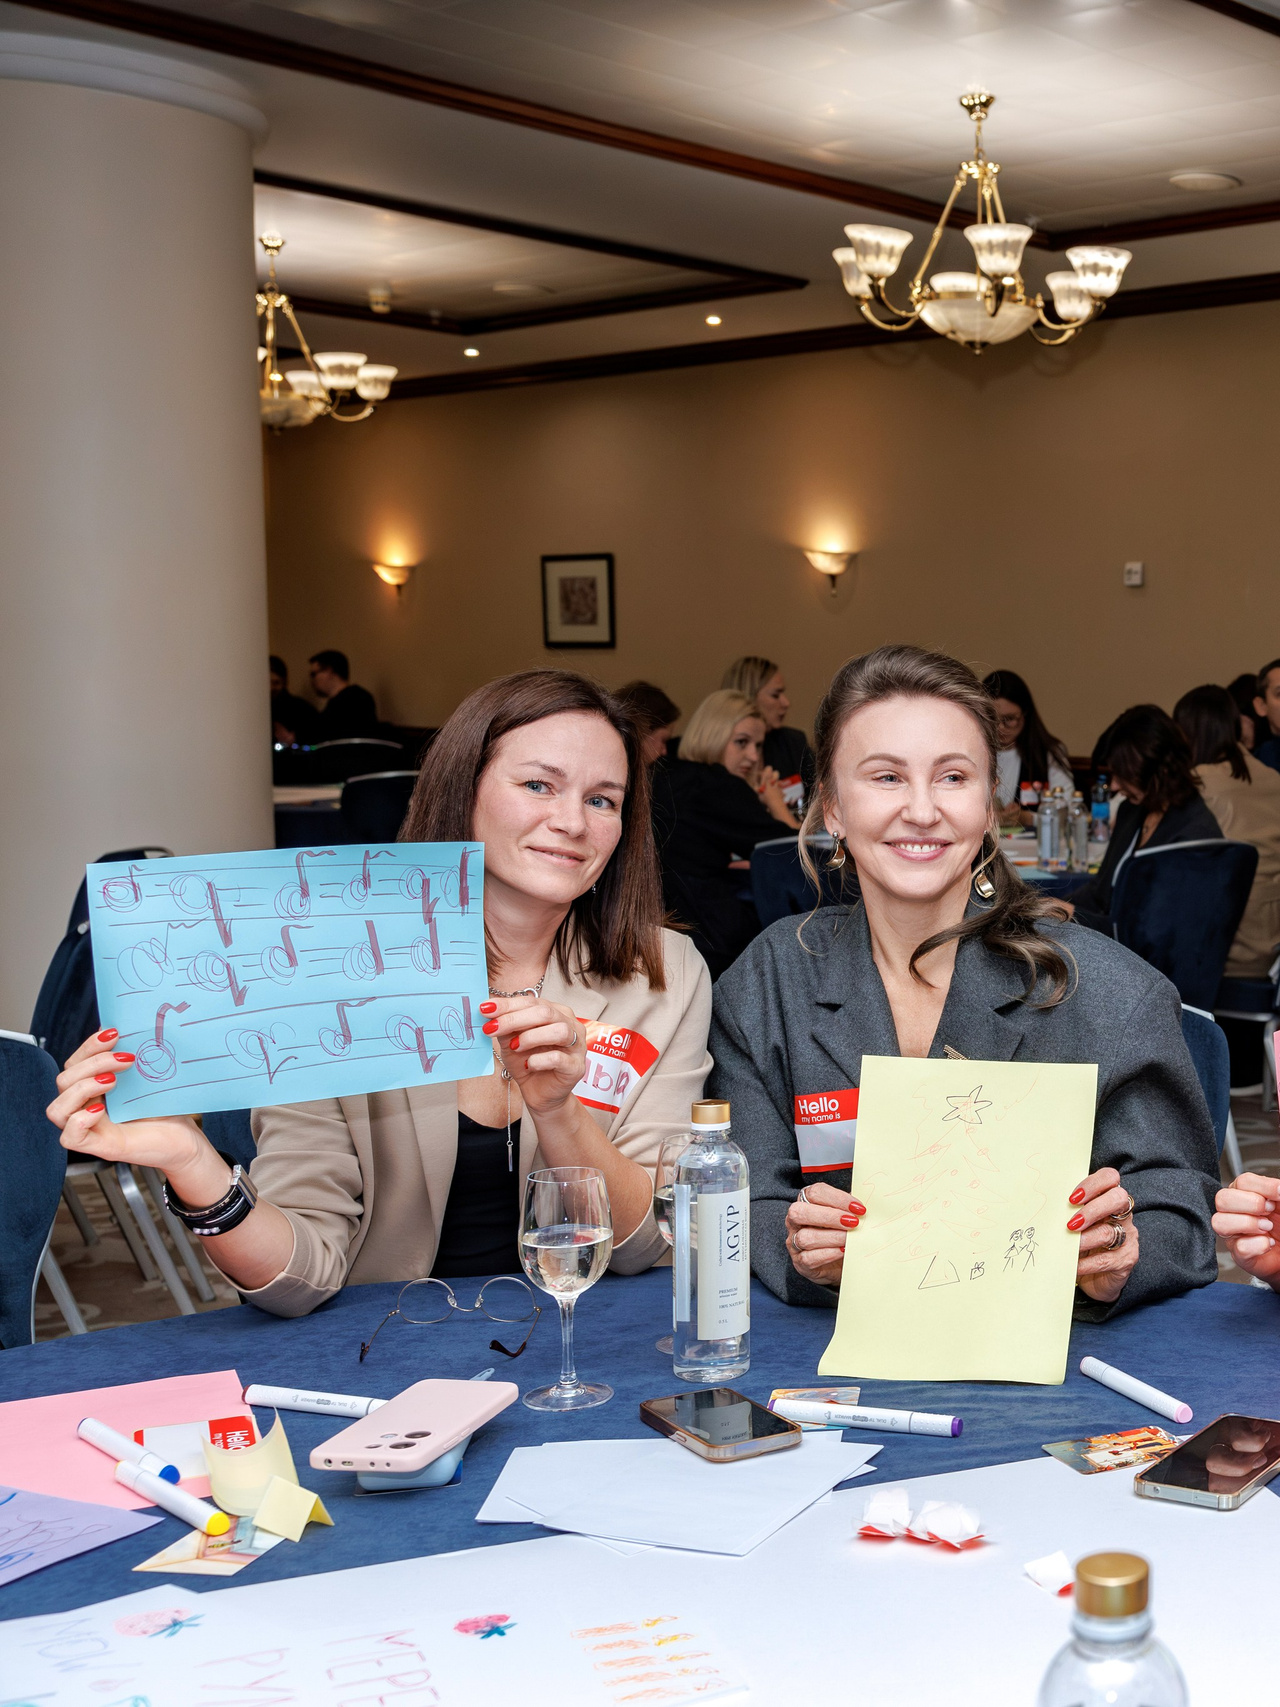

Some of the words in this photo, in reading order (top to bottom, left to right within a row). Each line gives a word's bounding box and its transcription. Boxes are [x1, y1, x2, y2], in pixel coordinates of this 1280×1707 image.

[592, 1043, 608, 1054] my
[798, 1096, 840, 1115] Hello
[801, 1116, 811, 1124] my
[811, 1113, 834, 1123] name
[834, 1111, 841, 1120] is
[726, 1205, 740, 1262] AGVP
[718, 1287, 738, 1295] PREMIUM
